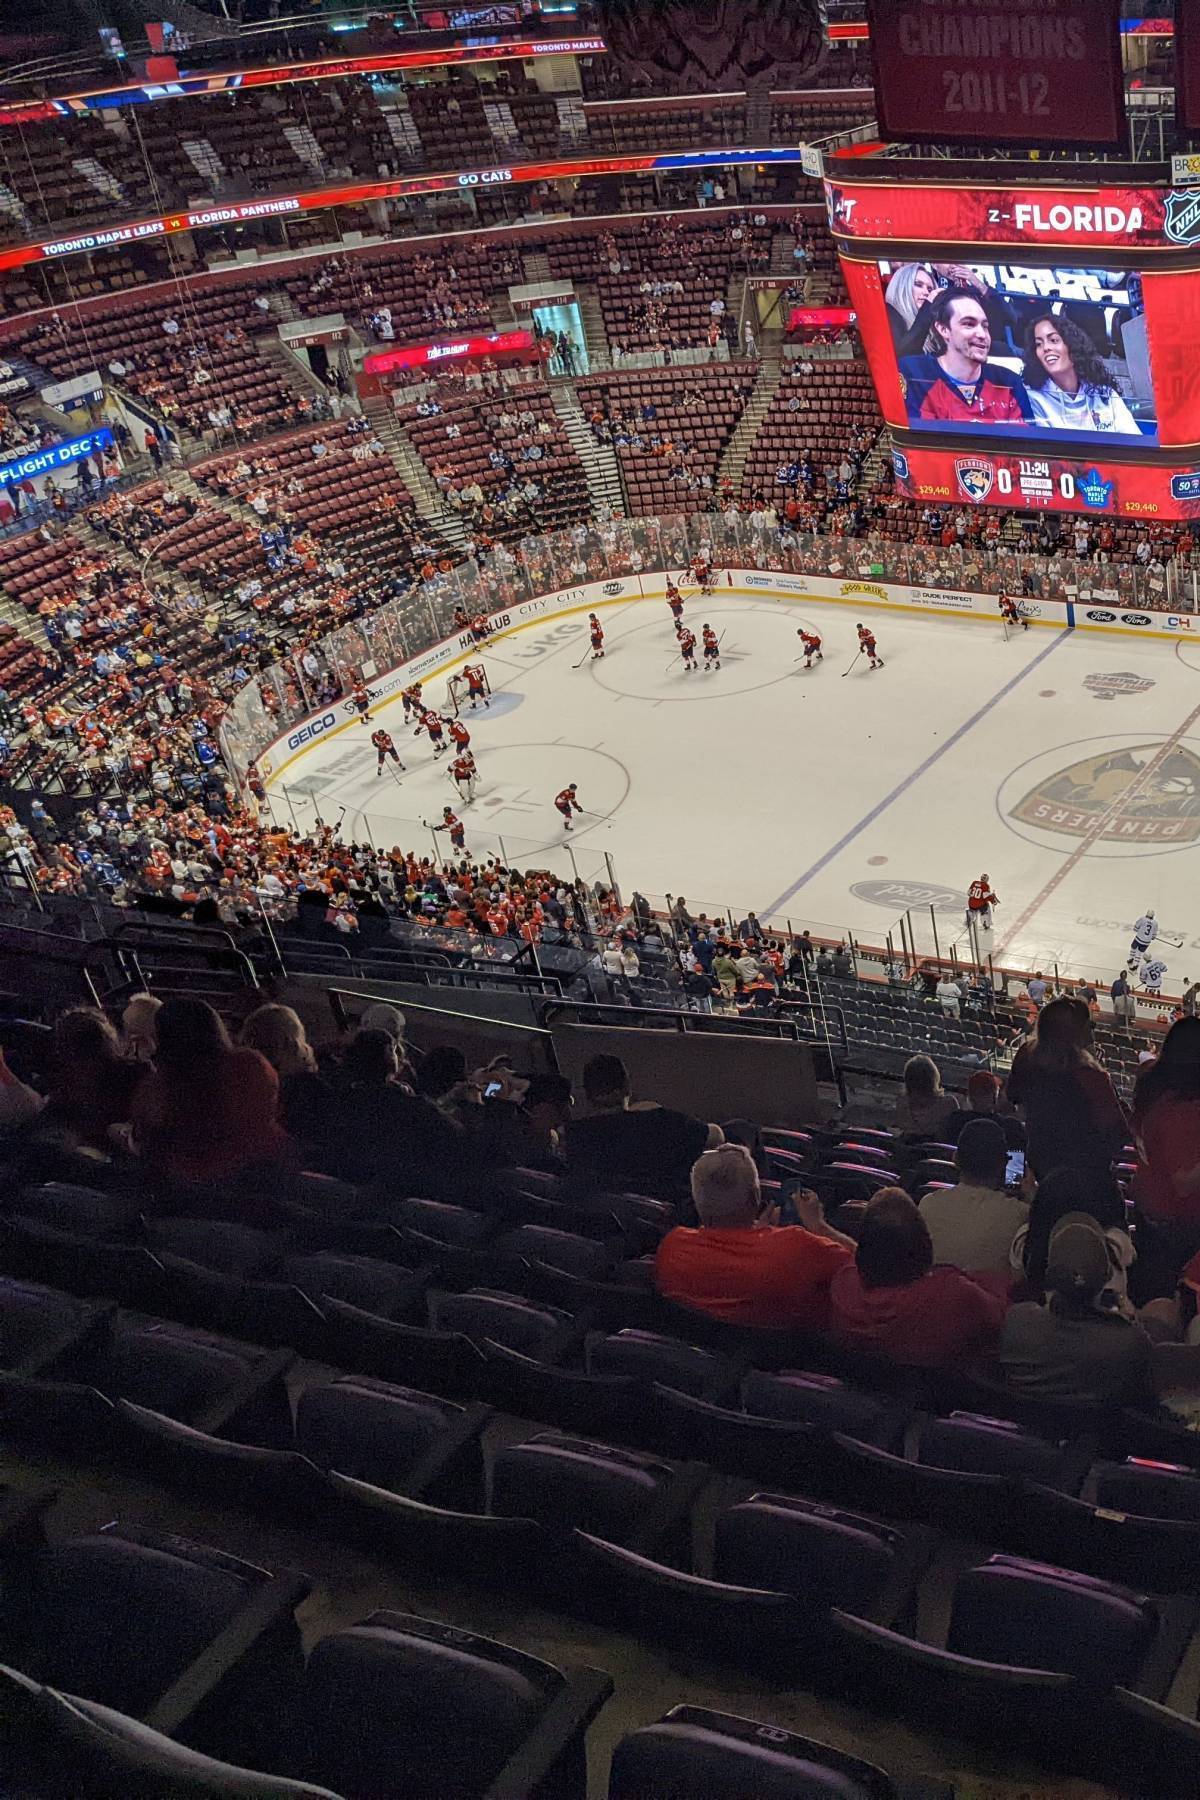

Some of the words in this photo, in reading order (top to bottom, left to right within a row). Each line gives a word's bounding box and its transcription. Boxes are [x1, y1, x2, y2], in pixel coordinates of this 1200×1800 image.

[900, 13, 1087, 59] CHAMPIONS
[532, 43, 571, 53] TORONTO
[572, 41, 599, 50] MAPLE
[943, 70, 1050, 114] 2011-12
[458, 174, 479, 185] GO
[481, 170, 513, 183] CATS
[1015, 203, 1142, 233] FLORIDA
[42, 237, 95, 256] TORONTO
[96, 229, 133, 245] MAPLE
[133, 222, 165, 238] LEAFS
[189, 209, 239, 226] FLORIDA
[240, 199, 300, 217] PANTHERS
[0, 452, 55, 483] FLIGHT
[1020, 461, 1050, 477] 11:24
[997, 468, 1012, 494] 0
[1060, 473, 1075, 499] 0
[1178, 481, 1191, 491] 50
[919, 485, 950, 496] $29,440
[1125, 501, 1158, 513] $29,440
[557, 589, 587, 603] CITY
[942, 594, 972, 603] PERFECT
[519, 600, 547, 615] CITY
[1091, 610, 1112, 621] Ford
[1126, 614, 1147, 625] Ford
[1168, 616, 1191, 628] CH
[287, 713, 336, 750] GEICO
[458, 725, 466, 734] 8
[1034, 804, 1181, 835] PANTHERS
[970, 887, 982, 900] 30
[1144, 924, 1152, 936] 3
